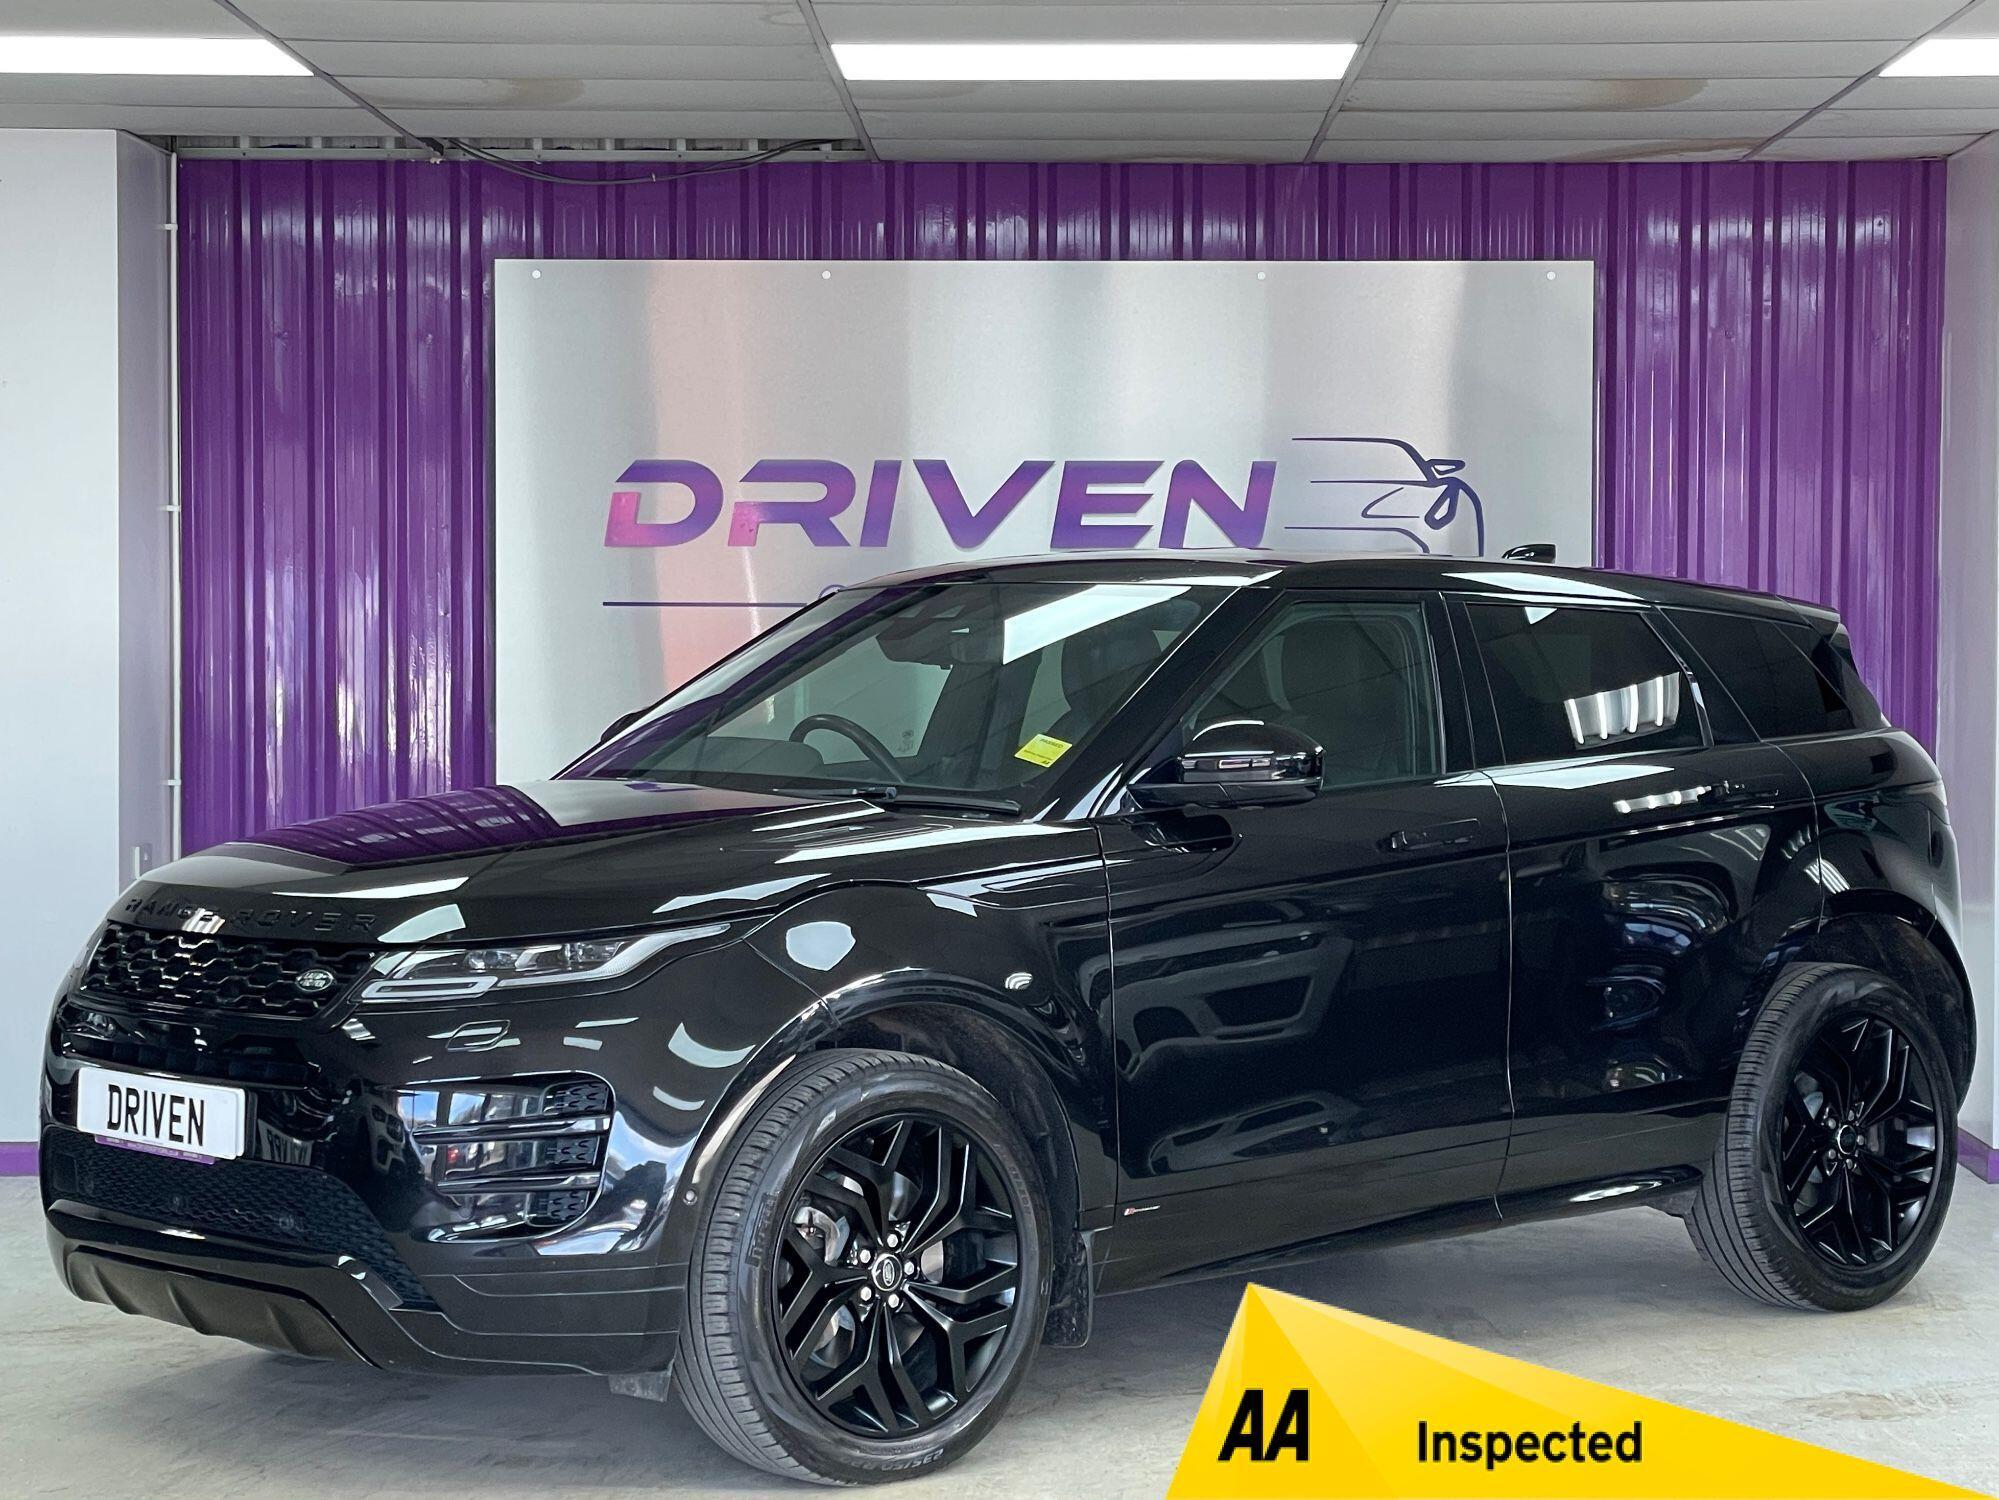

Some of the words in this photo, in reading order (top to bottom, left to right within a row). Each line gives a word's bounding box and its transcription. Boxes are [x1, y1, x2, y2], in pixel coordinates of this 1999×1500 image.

[604, 459, 1277, 548] DRIVEN
[232, 907, 377, 932] ROVER
[107, 1084, 205, 1147] DRIVEN
